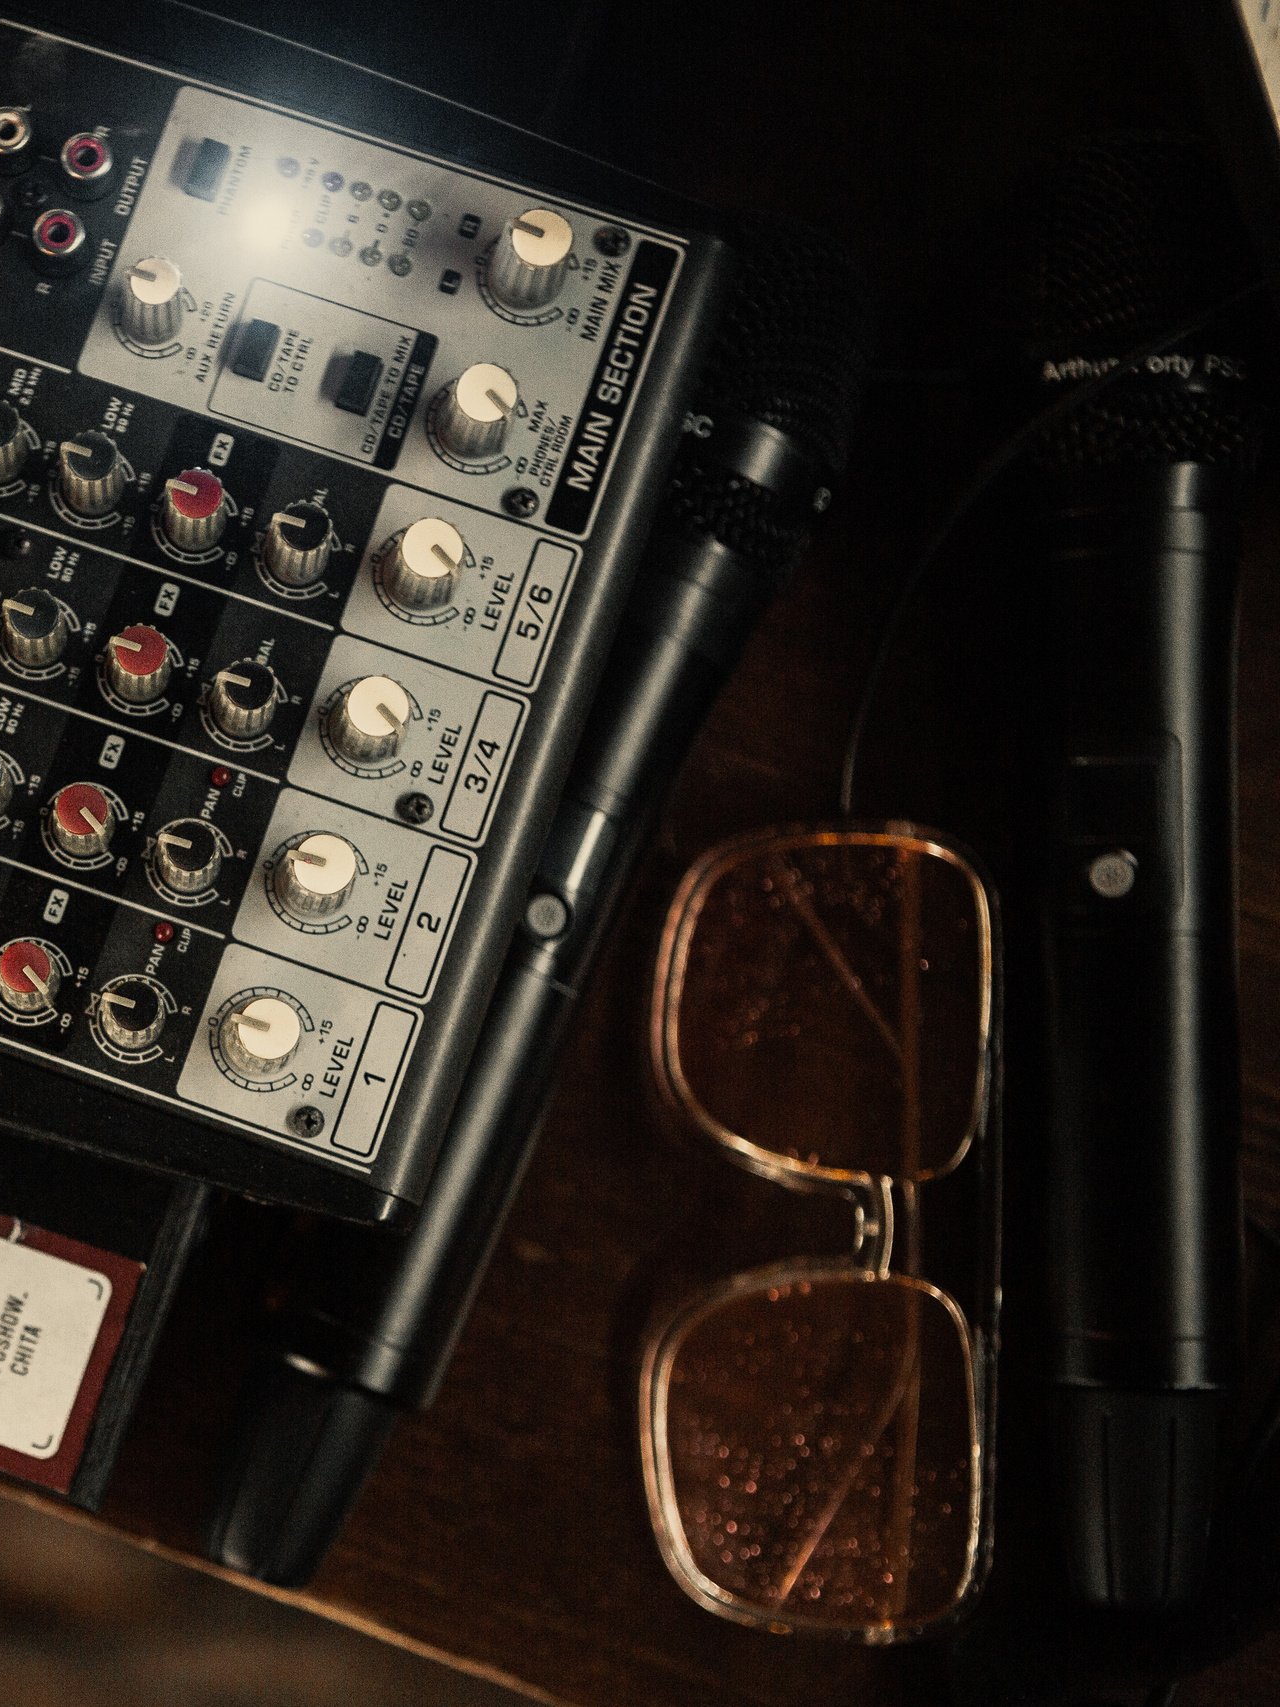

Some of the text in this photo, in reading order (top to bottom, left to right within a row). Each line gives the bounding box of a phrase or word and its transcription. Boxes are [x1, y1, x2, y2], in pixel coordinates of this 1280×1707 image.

[114, 156, 149, 216] OUTPUT
[88, 238, 117, 285] INPUT
[581, 260, 621, 341] MAIN MIX
[268, 328, 300, 392] CD/TAPE
[7, 367, 27, 395] MID
[360, 335, 412, 454] CD/TAPE TO MIX
[564, 281, 659, 491] MAIN SECTION
[101, 396, 122, 429] LOW
[386, 362, 425, 438] CD/TAPE
[527, 399, 548, 432] MAX
[214, 439, 229, 460] FX
[539, 415, 573, 486] CTRL ROOM
[46, 545, 68, 578] LOW
[158, 589, 175, 610] FX
[480, 568, 515, 630] LEVEL
[516, 583, 553, 640] 5/6
[104, 741, 120, 762] FX
[428, 721, 462, 784] LEVEL
[463, 737, 501, 793] 3/4
[232, 772, 249, 797] CLIP
[200, 787, 220, 819] PAN
[371, 862, 388, 886] +15
[47, 895, 64, 917] FX
[219, 896, 231, 905] L
[374, 876, 408, 939] LEVEL
[416, 911, 441, 932] 2
[177, 927, 193, 953] CLIP
[145, 943, 165, 974] PAN
[73, 965, 89, 988] +15
[181, 1005, 192, 1015] R
[207, 1016, 219, 1027] 0
[316, 1019, 333, 1044] +15
[165, 1053, 175, 1062] L
[319, 1033, 354, 1098] LEVEL
[361, 1072, 385, 1089] 1
[9, 1323, 42, 1376] CHITA
